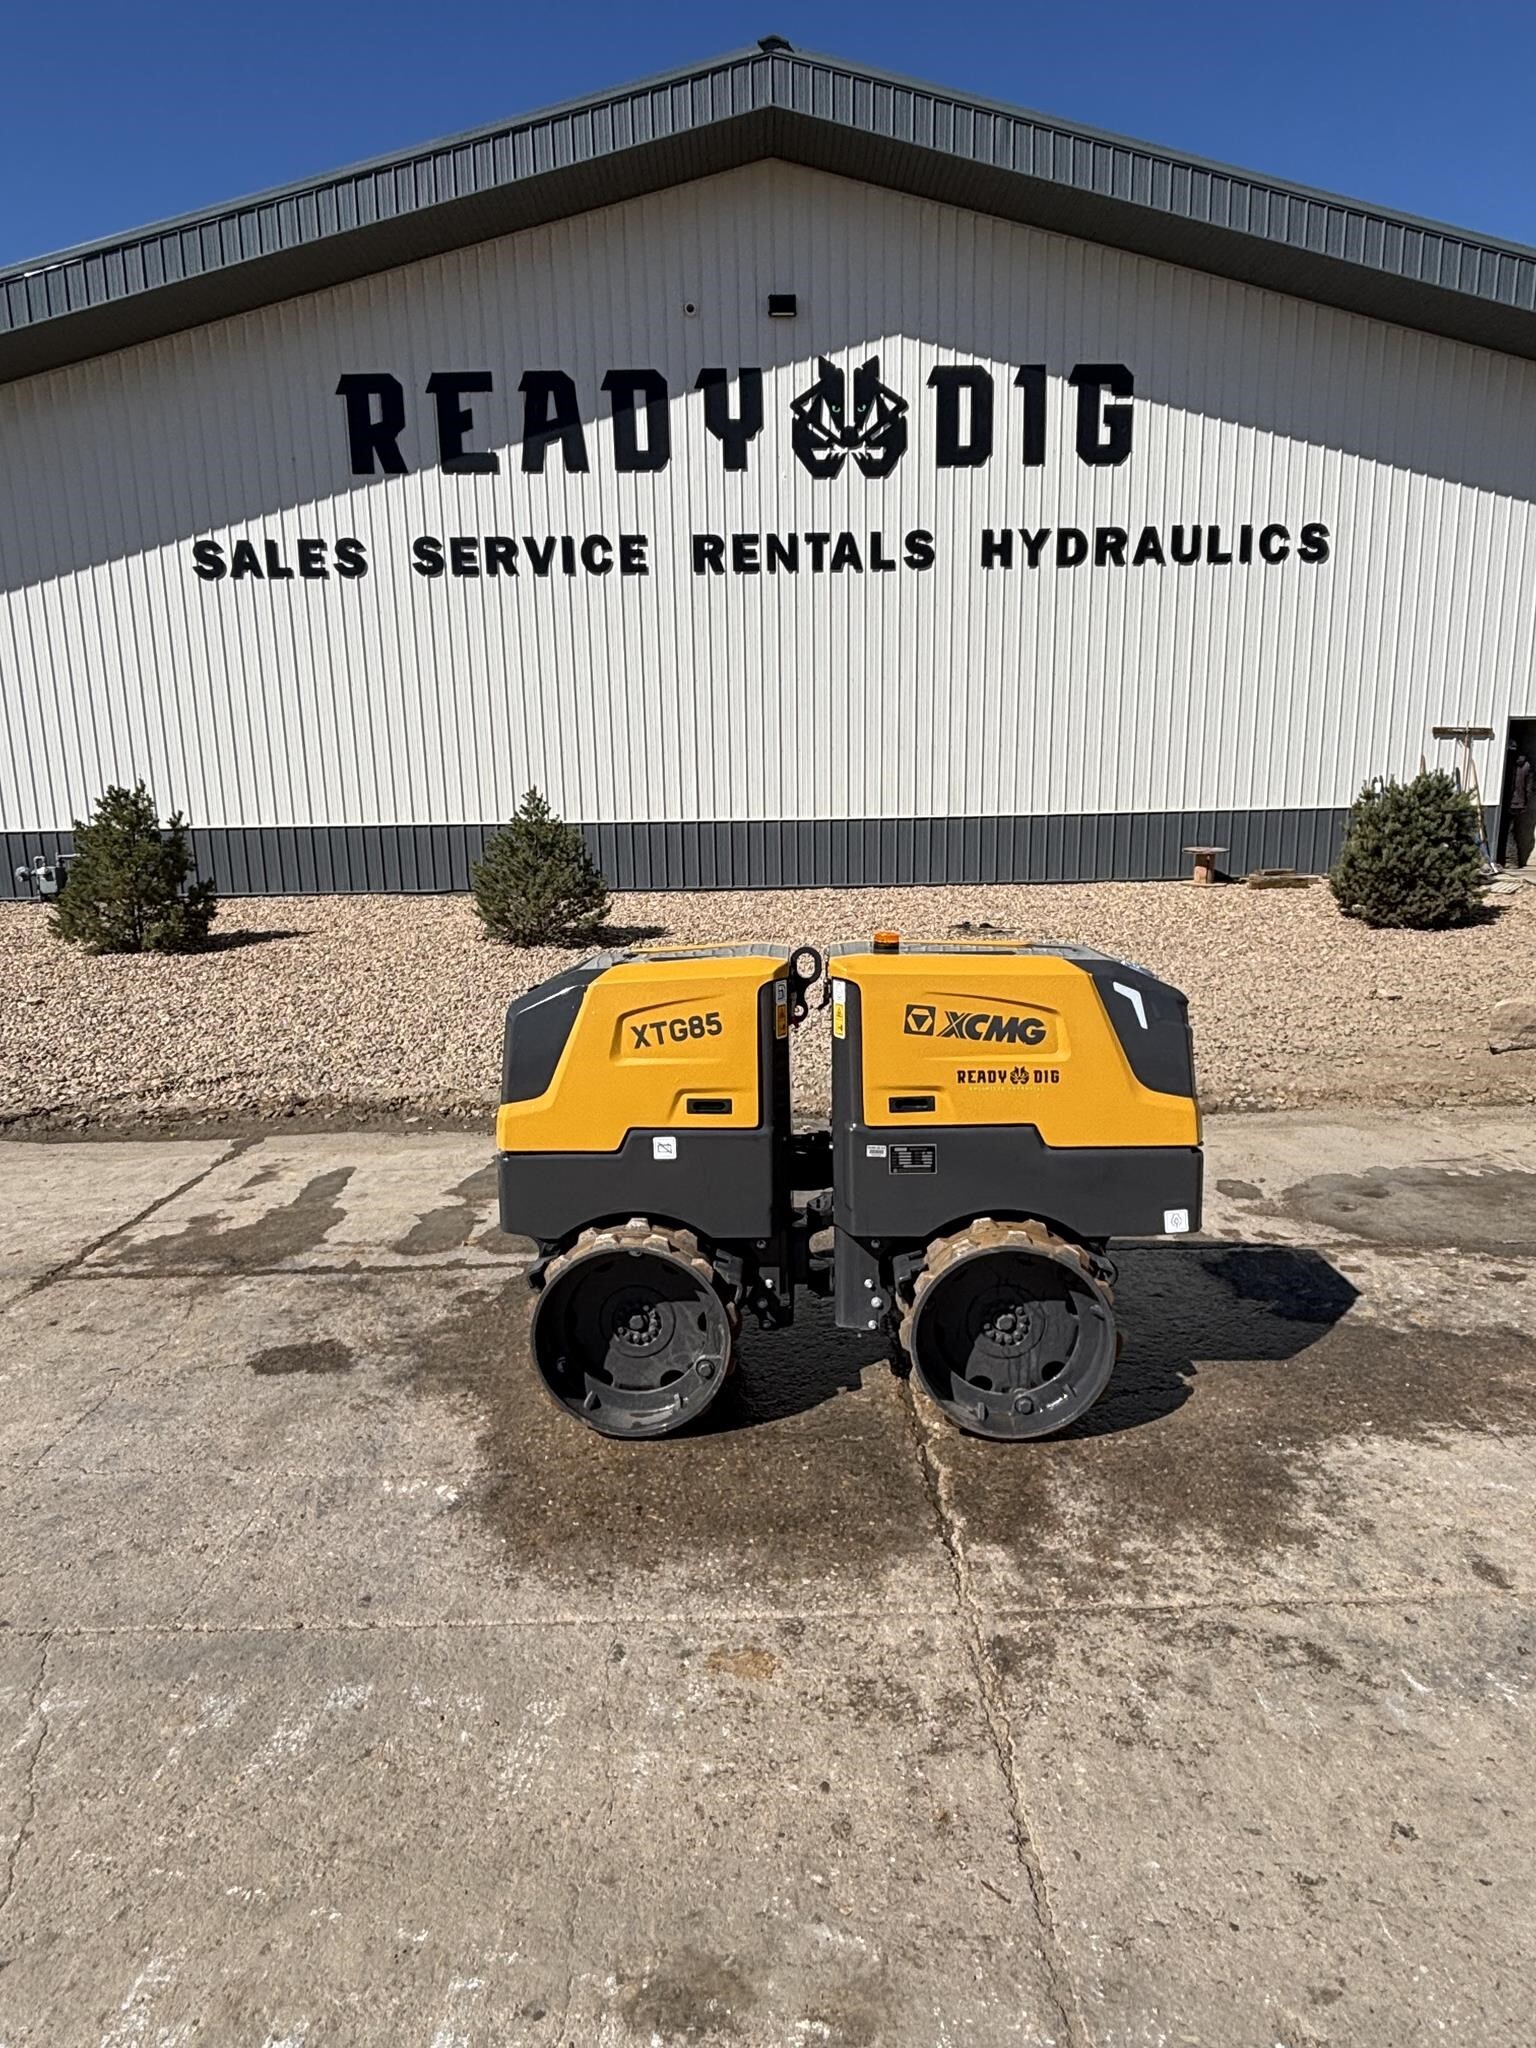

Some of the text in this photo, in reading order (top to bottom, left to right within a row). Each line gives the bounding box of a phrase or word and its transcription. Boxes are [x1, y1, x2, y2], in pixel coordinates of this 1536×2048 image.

[336, 363, 1136, 475] READY DIG
[193, 523, 1330, 580] SALES SERVICE RENTALS HYDRAULICS
[630, 1011, 723, 1049] XTG85
[936, 1010, 1047, 1045] XCMG
[957, 1070, 1060, 1083] READY DIG
